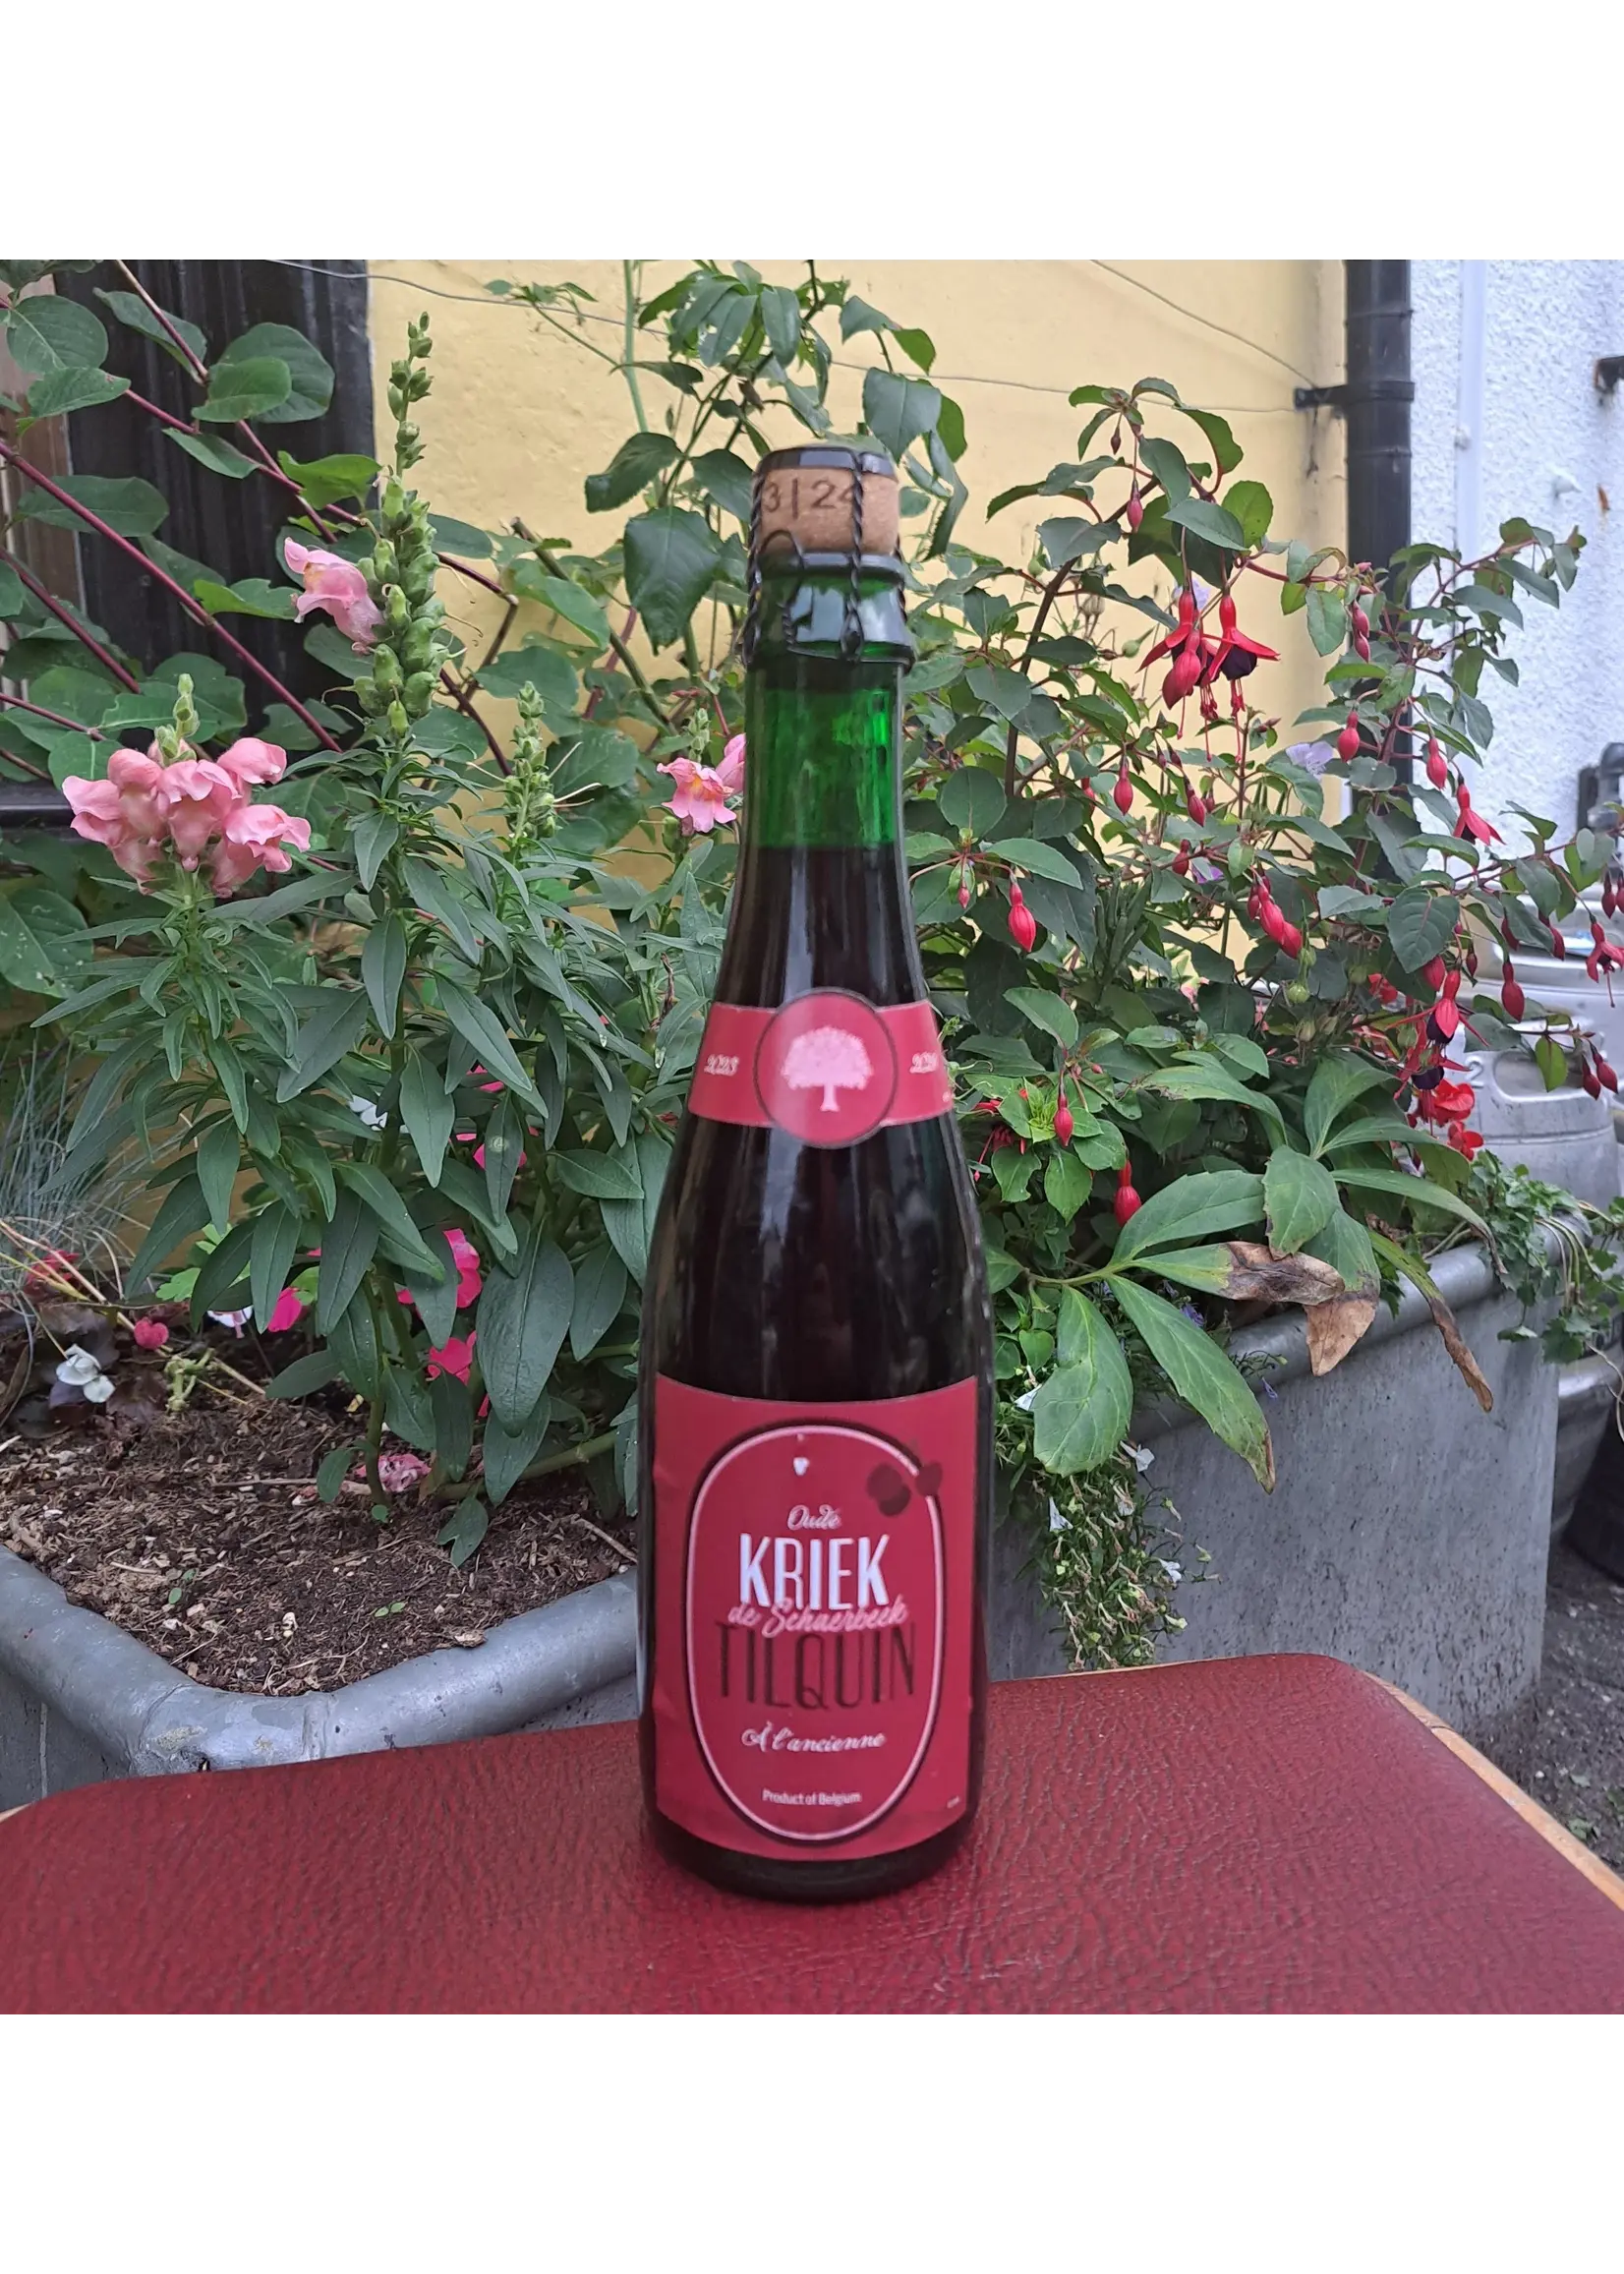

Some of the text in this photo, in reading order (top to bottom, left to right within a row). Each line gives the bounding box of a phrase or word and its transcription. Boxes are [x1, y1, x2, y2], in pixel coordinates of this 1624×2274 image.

[786, 1504, 841, 1531] Oude
[739, 1533, 890, 1611] KRIEK
[727, 1594, 909, 1639] de Schaerbeek
[714, 1621, 915, 1711] TILQUIN
[762, 1787, 863, 1807] Product of Belgium
